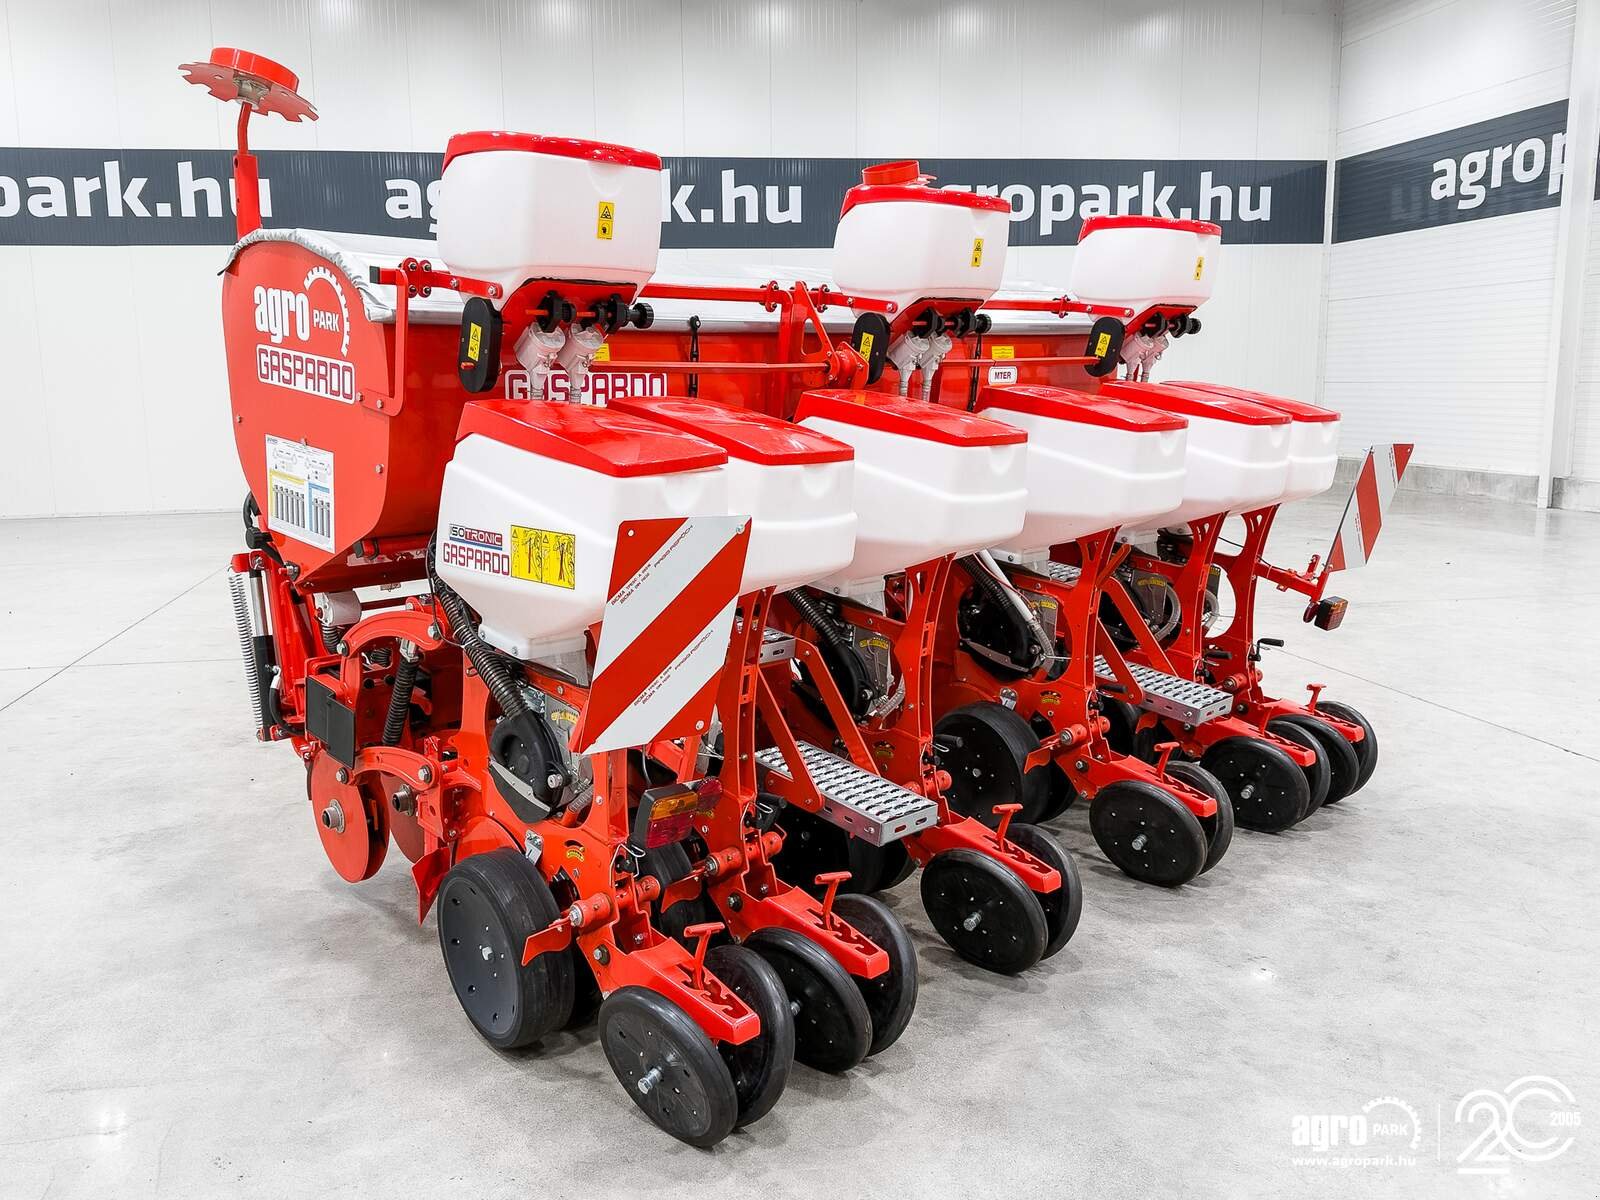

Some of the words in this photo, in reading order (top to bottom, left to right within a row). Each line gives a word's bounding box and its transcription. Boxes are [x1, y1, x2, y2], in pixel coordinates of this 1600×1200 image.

[254, 286, 310, 344] agro
[313, 309, 340, 332] PARK
[258, 347, 353, 400] GASPARDO
[508, 373, 665, 405] GSARDO
[443, 542, 510, 576] GASPARDO
